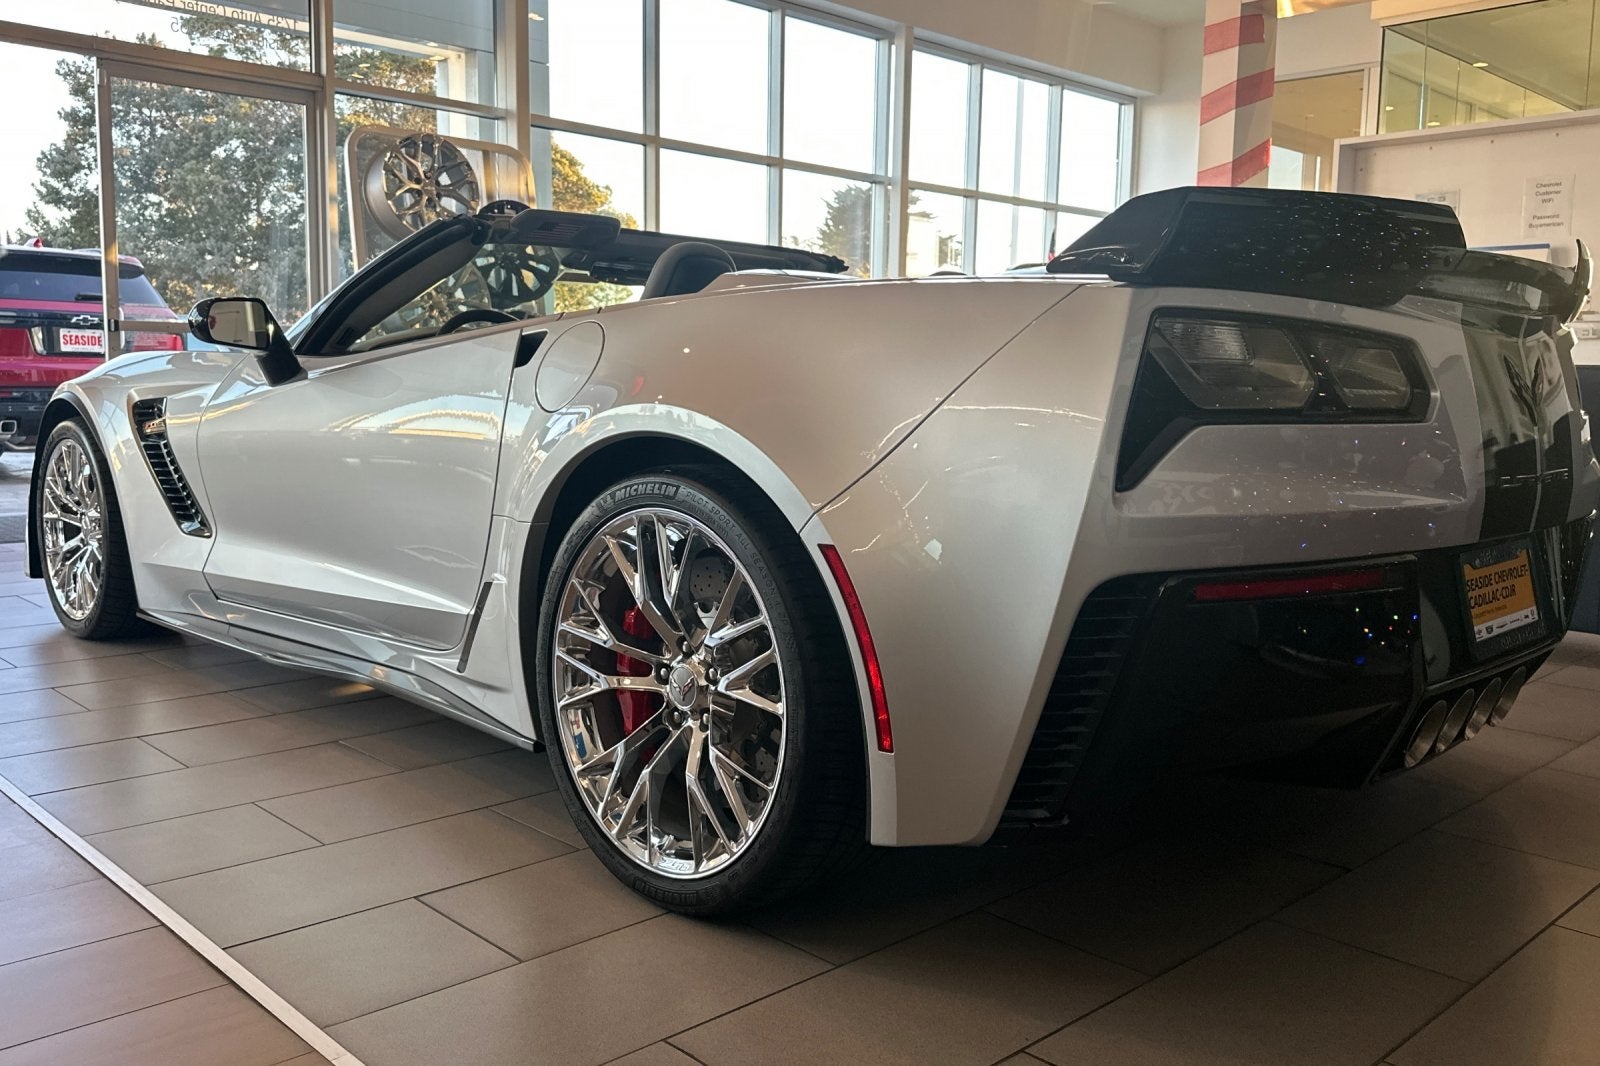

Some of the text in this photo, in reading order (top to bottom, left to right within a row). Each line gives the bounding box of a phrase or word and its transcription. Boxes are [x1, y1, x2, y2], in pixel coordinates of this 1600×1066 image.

[62, 334, 102, 346] SEASIDE
[615, 483, 677, 501] MICHELIN
[686, 491, 710, 510] PILOT
[710, 506, 736, 530] SPORT
[735, 532, 750, 550] ALL
[751, 552, 777, 596] SEASON
[1466, 564, 1529, 592] SEASIDE CHEVROLET-
